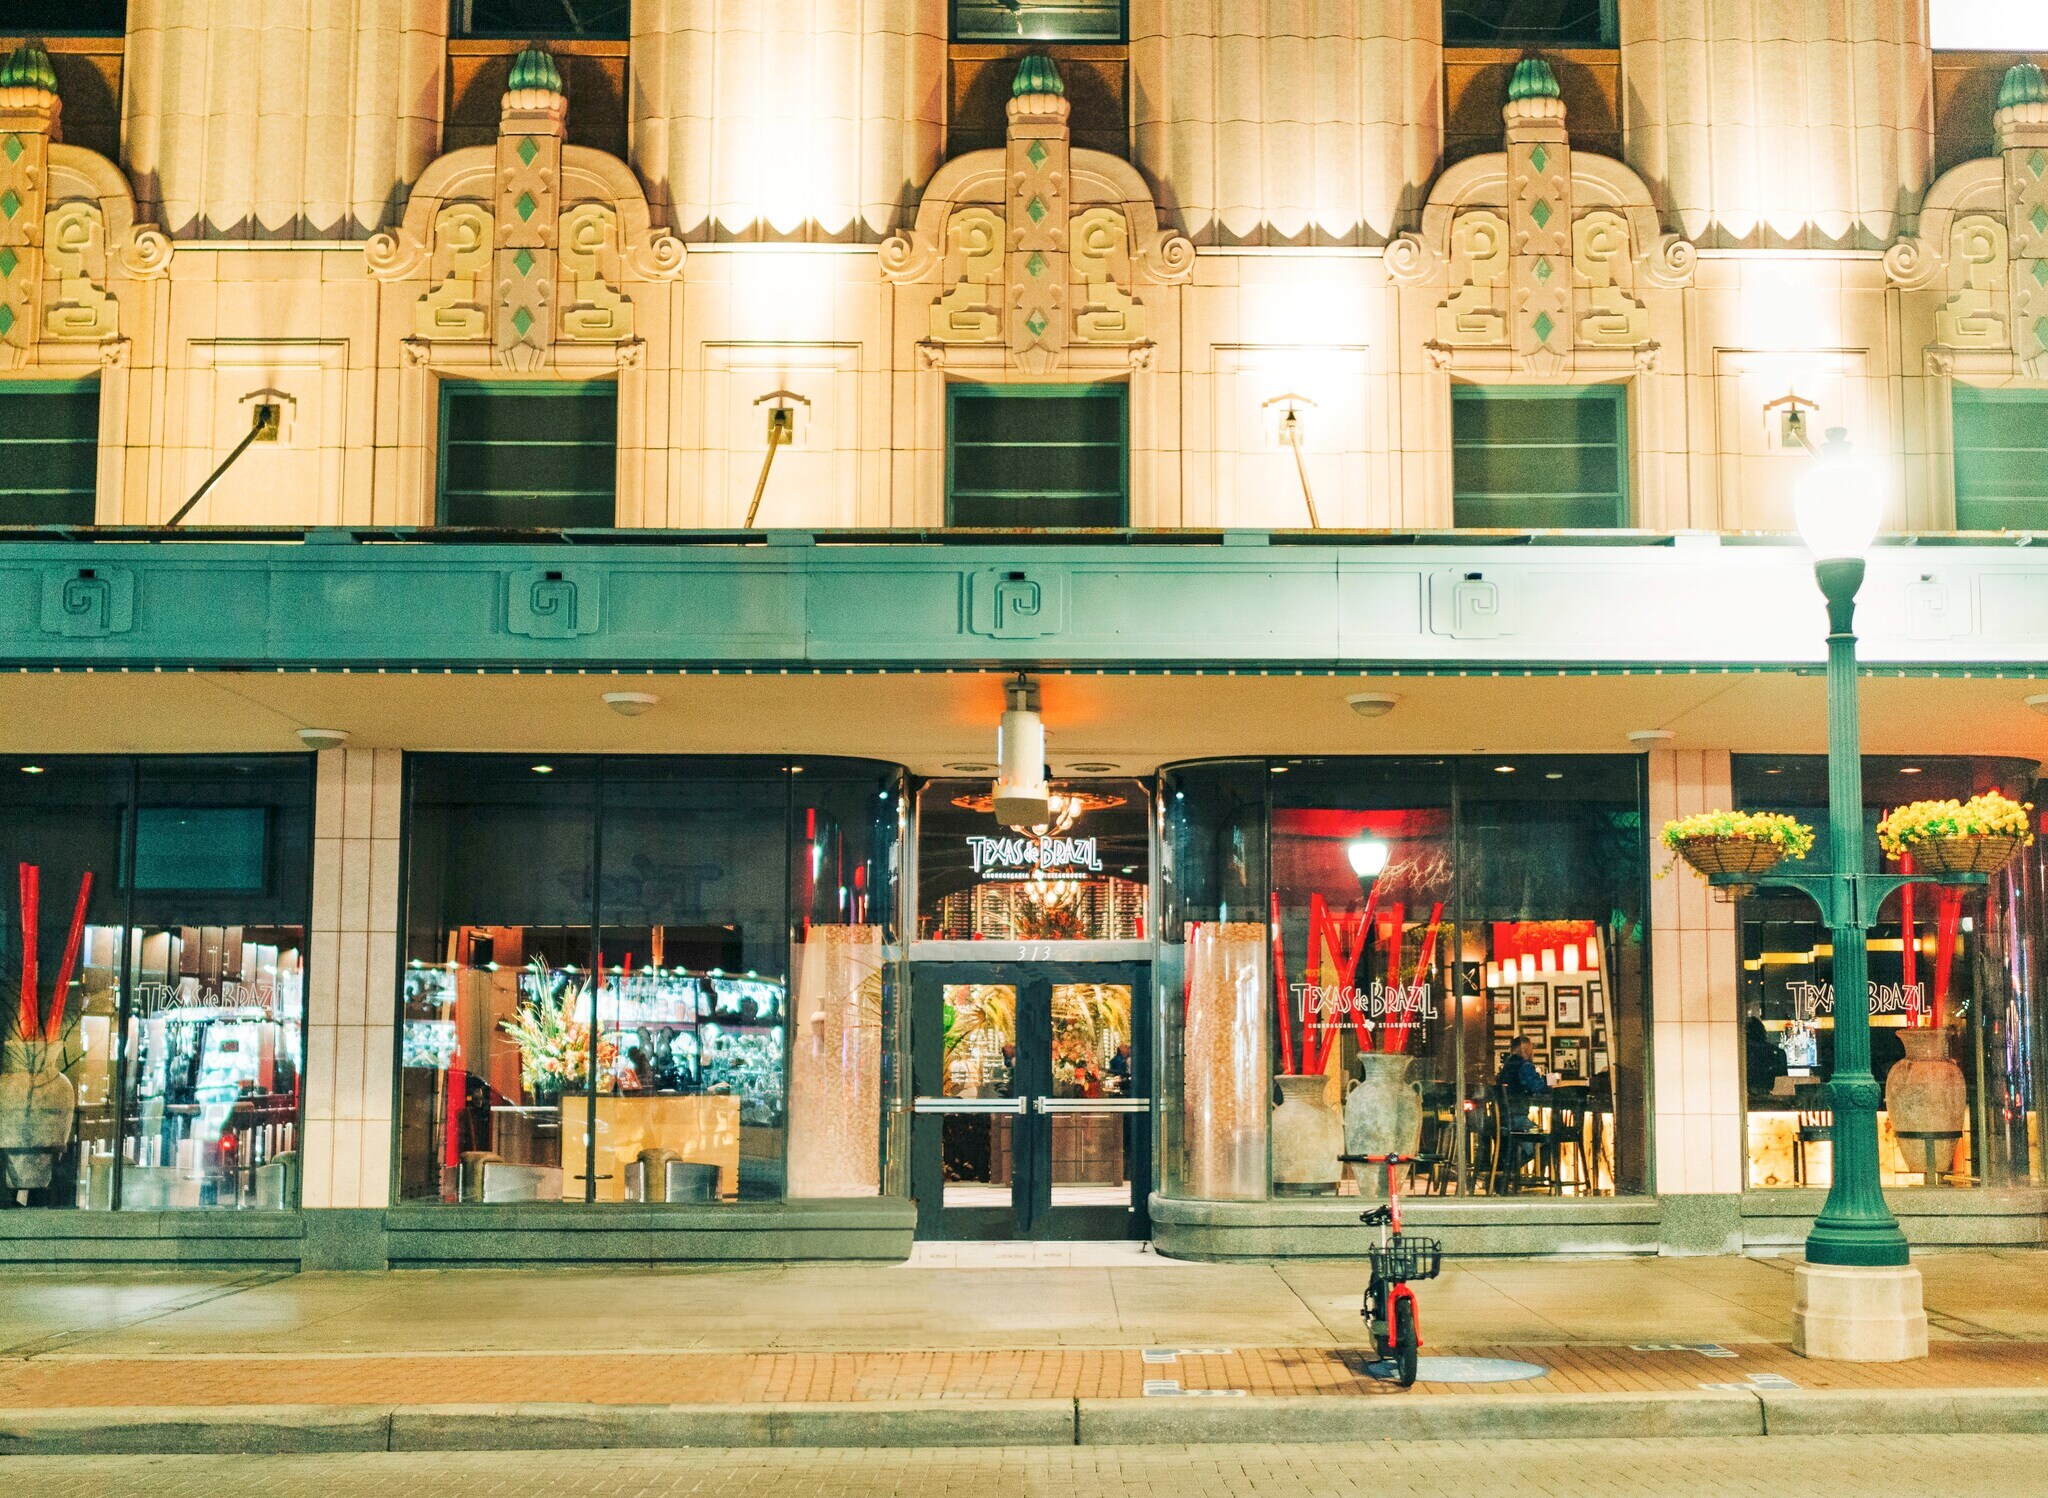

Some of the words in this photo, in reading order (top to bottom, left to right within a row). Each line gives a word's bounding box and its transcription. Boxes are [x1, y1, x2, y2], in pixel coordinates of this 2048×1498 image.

[966, 836, 1025, 873] TEXAS
[1024, 841, 1039, 863] de
[1040, 836, 1103, 871] BRAZIL
[1018, 946, 1051, 961] 313
[1290, 983, 1353, 1022] TEXAS
[1353, 988, 1369, 1011] de
[1371, 982, 1438, 1019] BRAZIL
[1786, 981, 1835, 1020] TEXA
[1867, 981, 1932, 1017] BRAZIL
